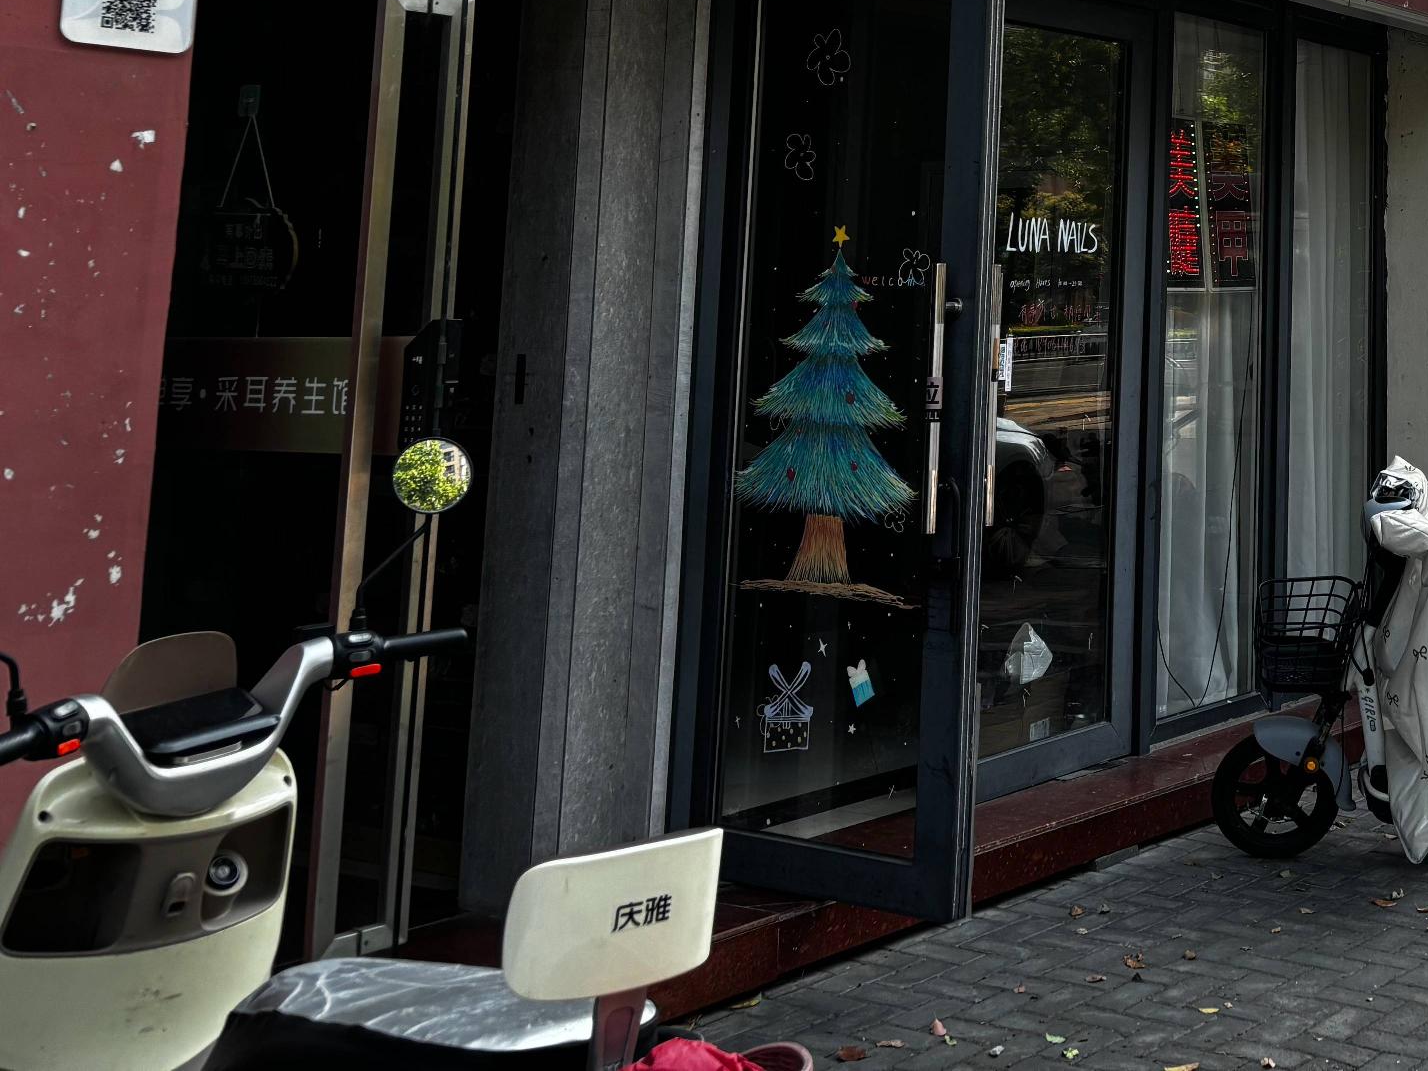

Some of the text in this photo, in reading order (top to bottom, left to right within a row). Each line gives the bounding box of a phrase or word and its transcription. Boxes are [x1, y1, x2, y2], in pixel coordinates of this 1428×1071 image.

[1005, 212, 1099, 255] LUNA NAILS
[610, 894, 673, 934] 庆雅
